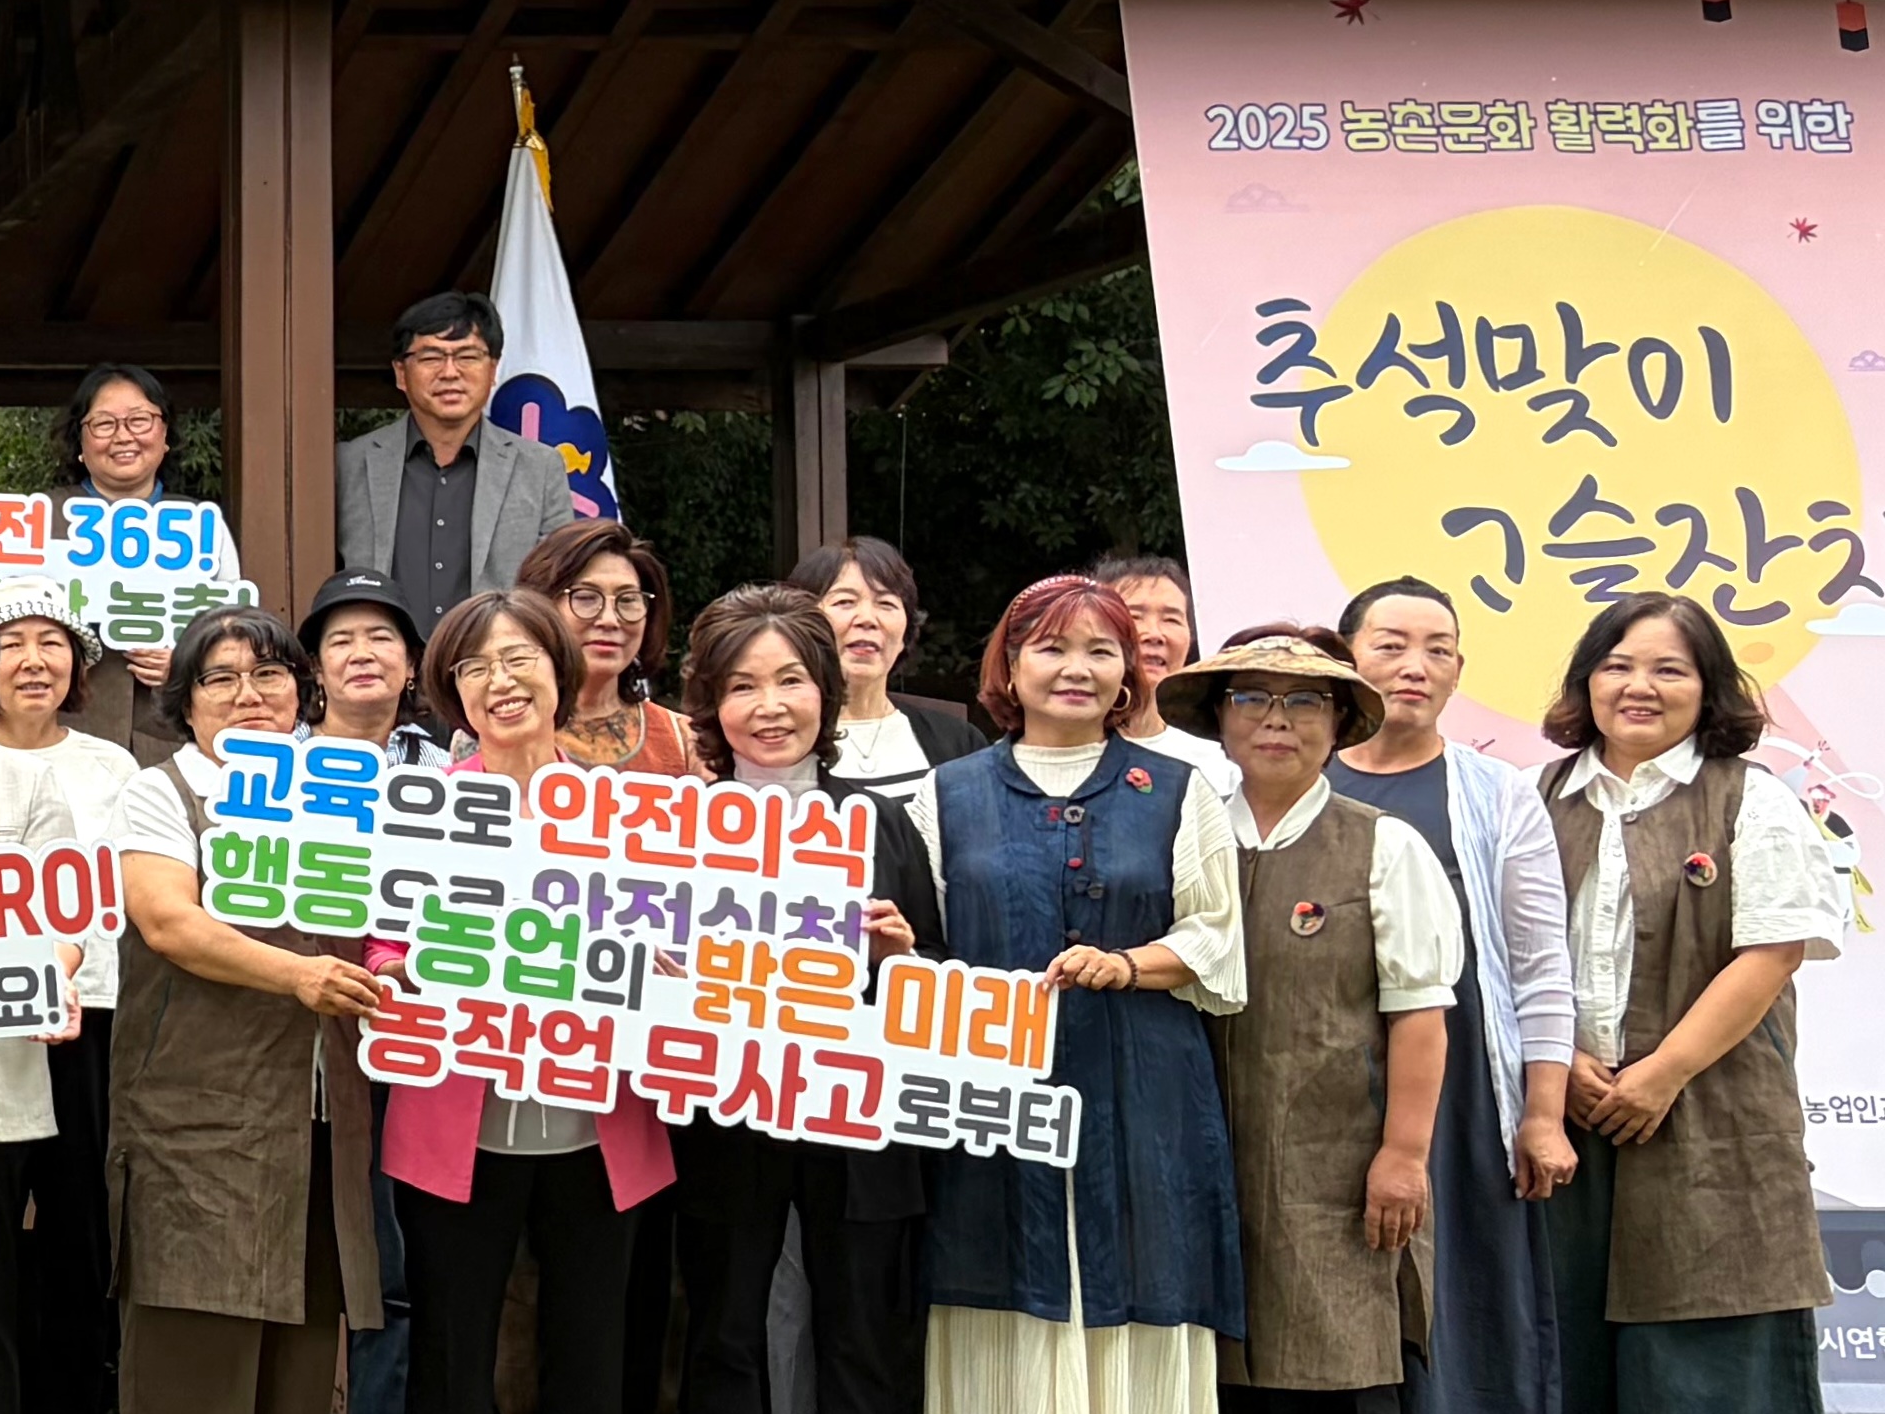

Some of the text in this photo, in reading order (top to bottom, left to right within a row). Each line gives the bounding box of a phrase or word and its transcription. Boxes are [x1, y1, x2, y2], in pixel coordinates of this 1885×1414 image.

[1206, 100, 1853, 153] 2025 농촌문화 활력화를 위한
[1250, 298, 1729, 447] 추석맞이
[67, 503, 213, 571] 365!
[216, 739, 865, 888] 교육으로 안전의식
[415, 893, 1049, 1069] 농업의 밝은 미래
[367, 983, 1073, 1160] 농작업 무사고로부터
